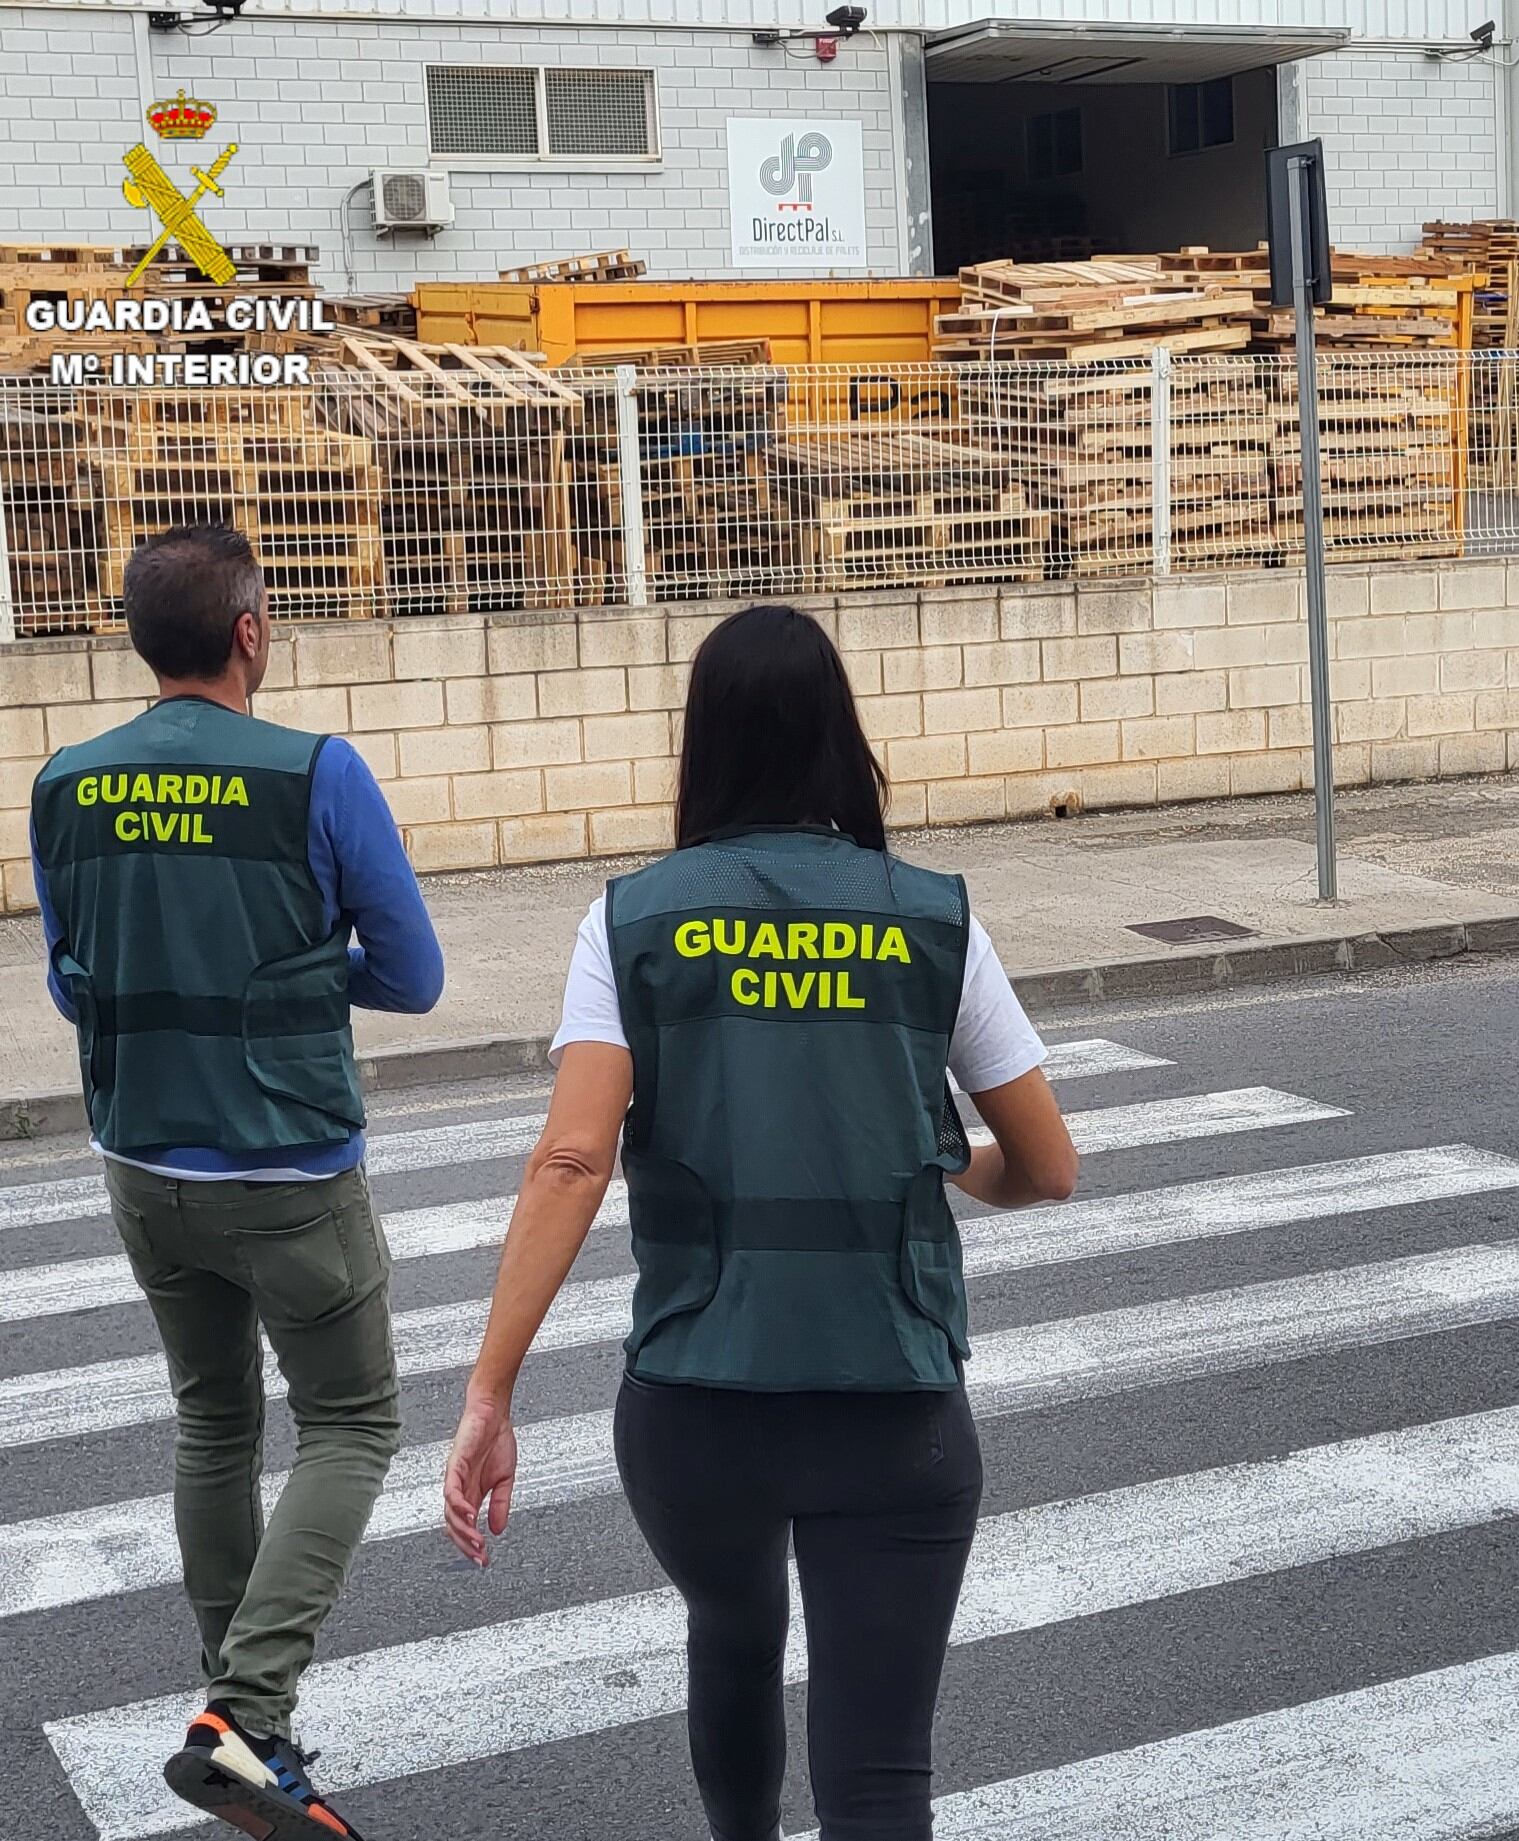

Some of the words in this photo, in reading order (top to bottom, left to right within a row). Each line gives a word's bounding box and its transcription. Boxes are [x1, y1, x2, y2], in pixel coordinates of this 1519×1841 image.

[752, 217, 829, 242] DirectPal
[77, 773, 250, 807] GUARDIA
[114, 811, 213, 844] CIVIL
[674, 918, 912, 964] GUARDIA
[731, 968, 866, 1009] CIVIL
